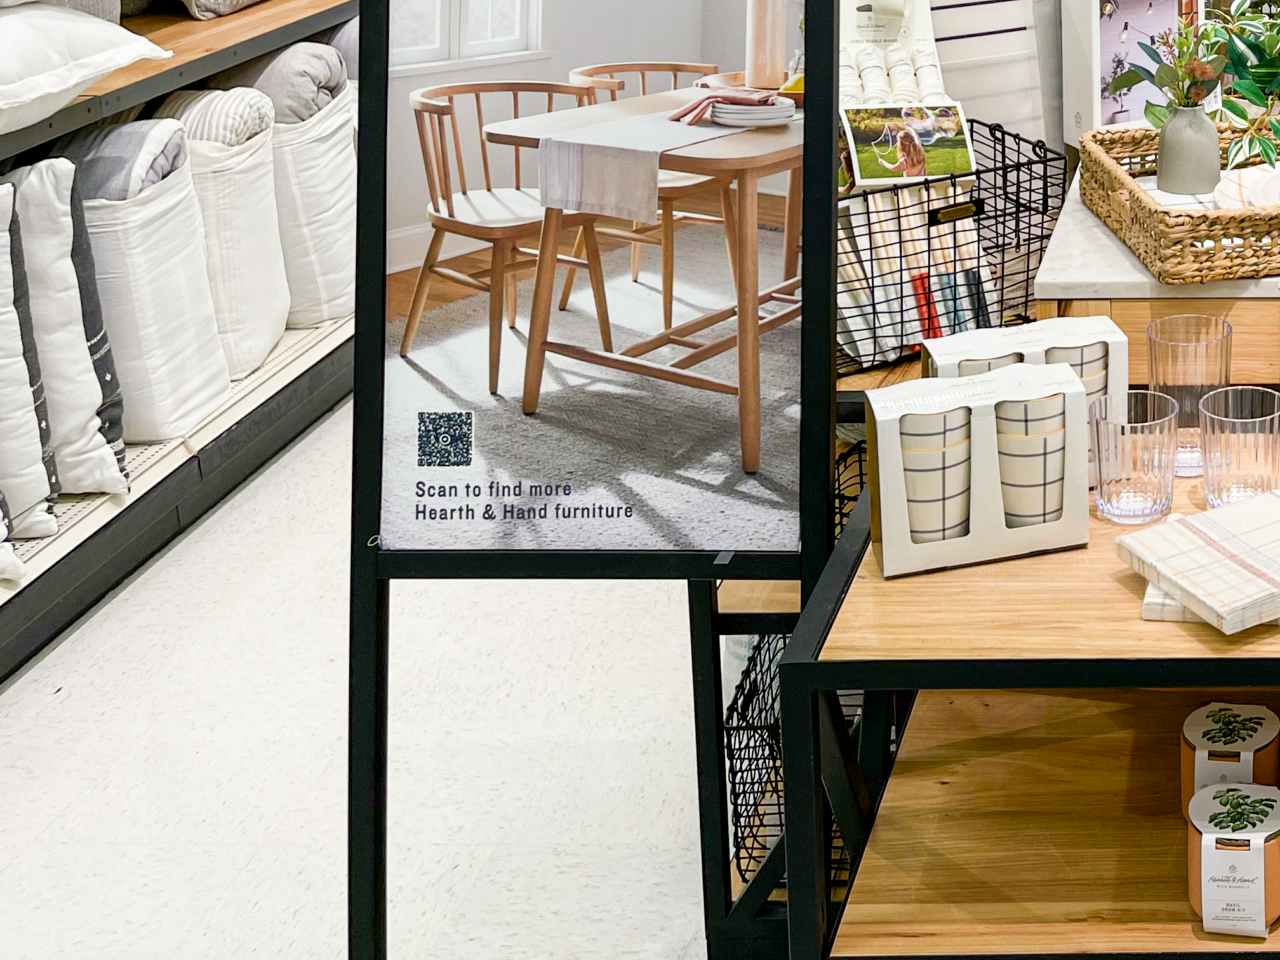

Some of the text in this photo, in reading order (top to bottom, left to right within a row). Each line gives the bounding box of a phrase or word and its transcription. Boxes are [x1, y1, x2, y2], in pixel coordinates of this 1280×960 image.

[415, 480, 572, 498] Scan to find more
[415, 503, 634, 521] Hearth & Hand furniture
